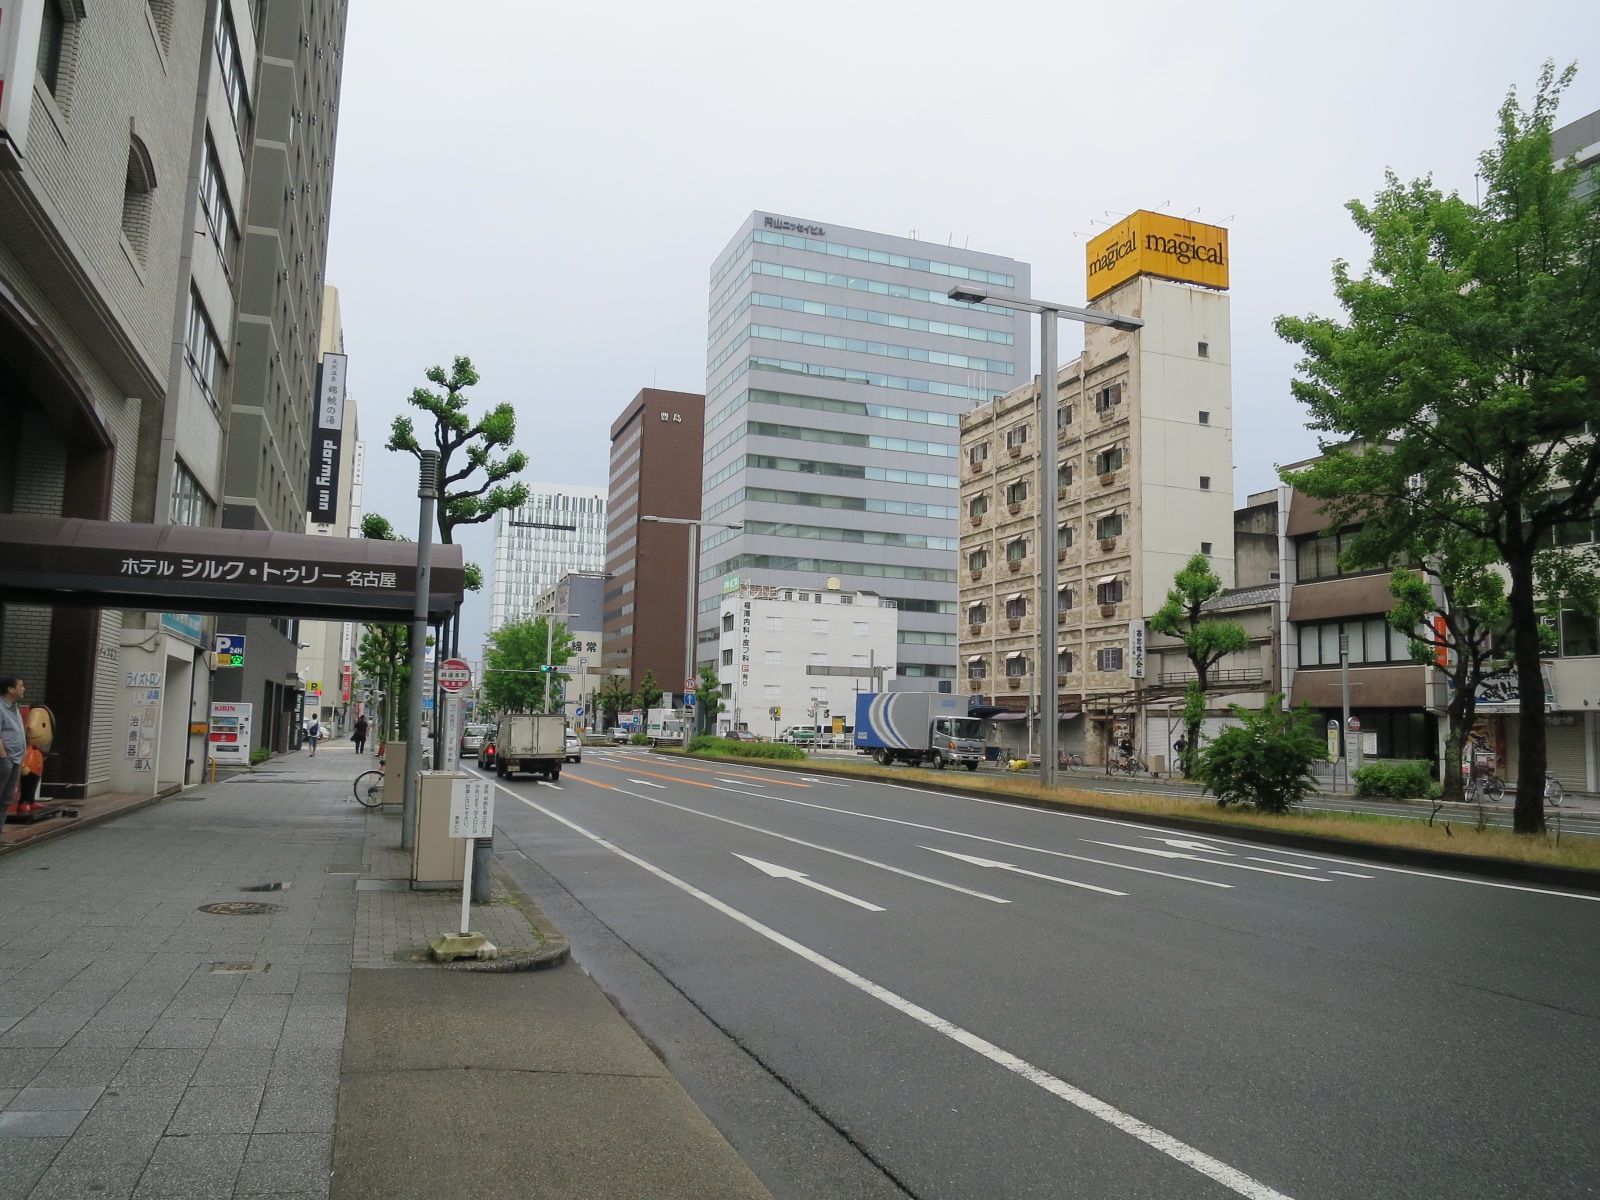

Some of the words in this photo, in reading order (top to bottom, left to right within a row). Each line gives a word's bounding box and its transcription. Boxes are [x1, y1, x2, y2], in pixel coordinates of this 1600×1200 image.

[1088, 230, 1137, 276] magical
[1145, 233, 1224, 266] magical
[315, 440, 338, 486] dormy
[318, 489, 330, 511] inn
[120, 557, 175, 577] ホテル
[181, 558, 342, 585] シルク・トゥリー
[346, 569, 397, 589] 名古屋
[216, 637, 231, 653] P
